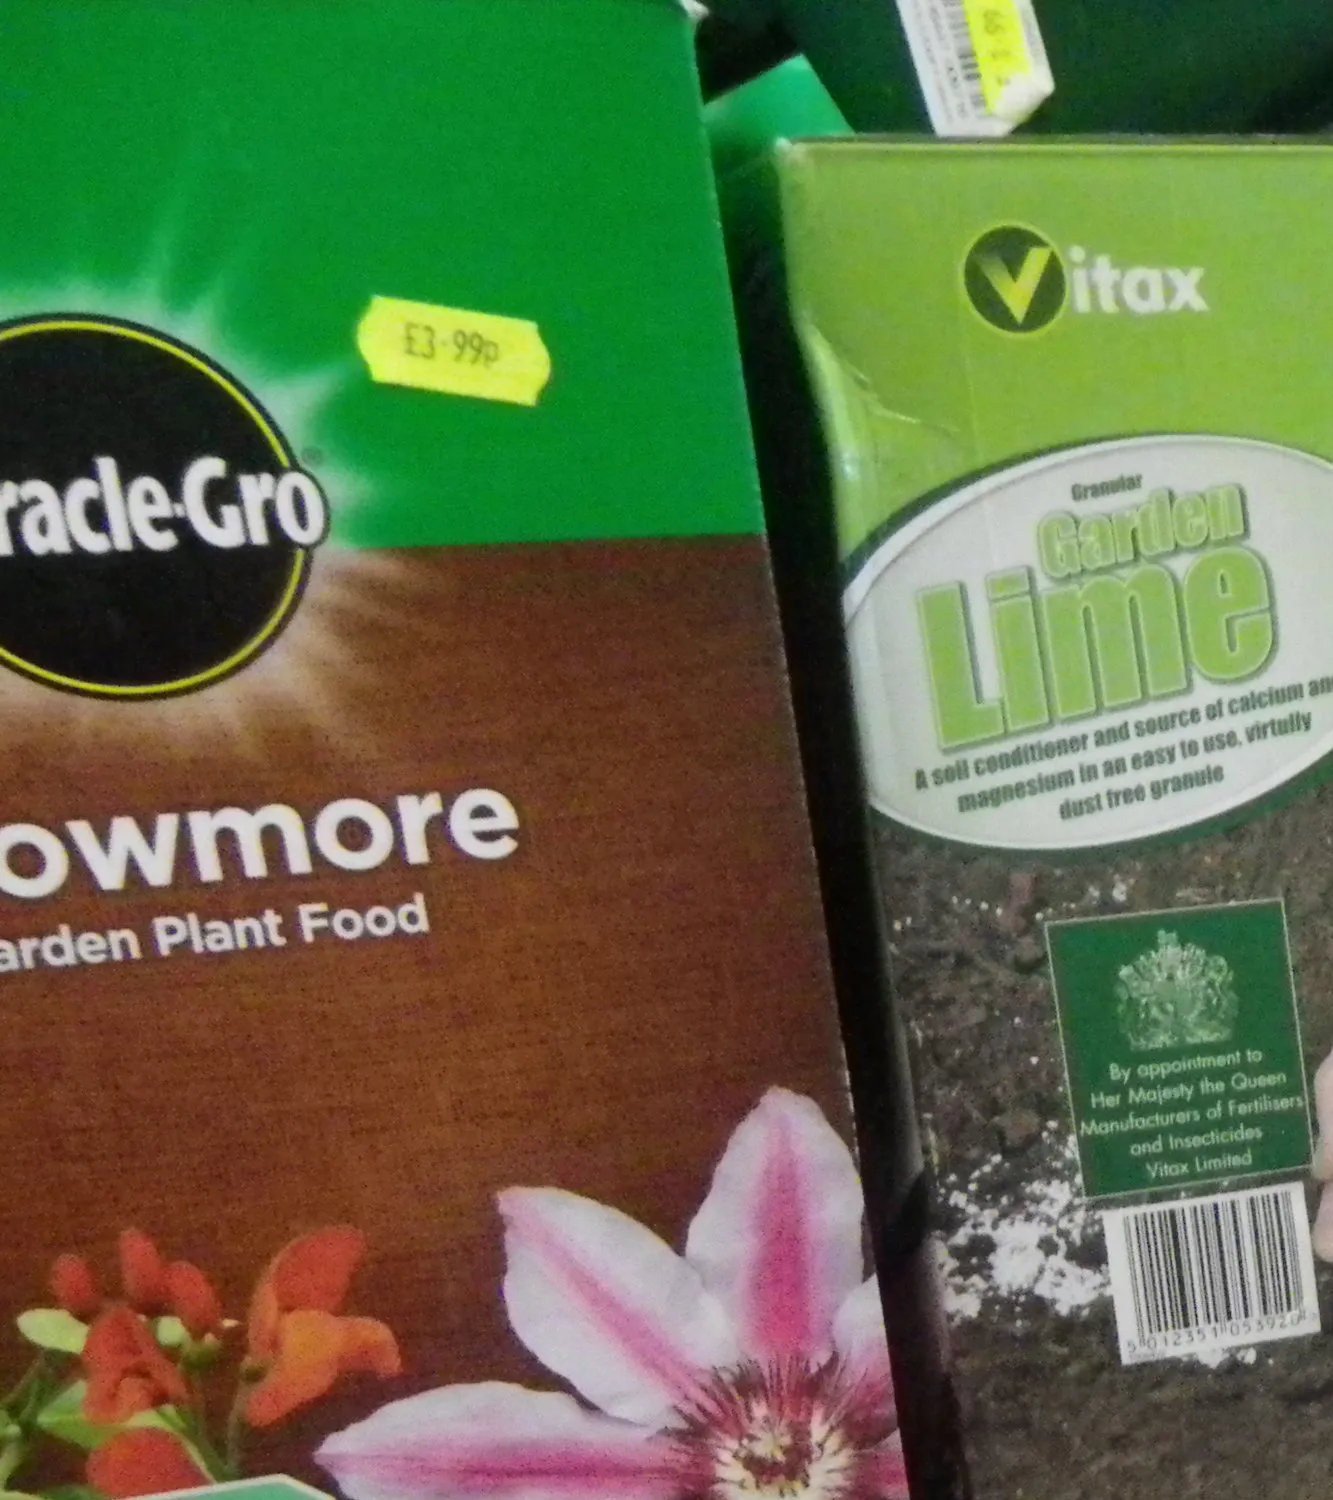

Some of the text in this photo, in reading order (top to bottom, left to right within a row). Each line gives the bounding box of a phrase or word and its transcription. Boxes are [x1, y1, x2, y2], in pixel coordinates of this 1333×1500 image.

[968, 244, 1210, 326] Vitax
[1071, 473, 1143, 502] Granular
[1037, 483, 1249, 579] Garden
[914, 544, 1277, 755] Lime
[932, 761, 970, 789] soil
[972, 730, 1090, 783] conditioner
[1094, 720, 1131, 750] and
[1134, 706, 1203, 739] source
[1226, 682, 1306, 718] calcium
[956, 736, 1201, 815] magnesium an easy to
[1058, 764, 1226, 822] dust free granule
[152, 907, 288, 957] Plant
[300, 893, 430, 942] Food
[1108, 1050, 1242, 1087] By appointment
[1126, 1066, 1288, 1112] Majesty the Queen
[1079, 1088, 1304, 1137] Manufacturers Fertilisers
[1129, 1121, 1264, 1157] and Insecticides
[1145, 1146, 1254, 1181] Vitax Limited
